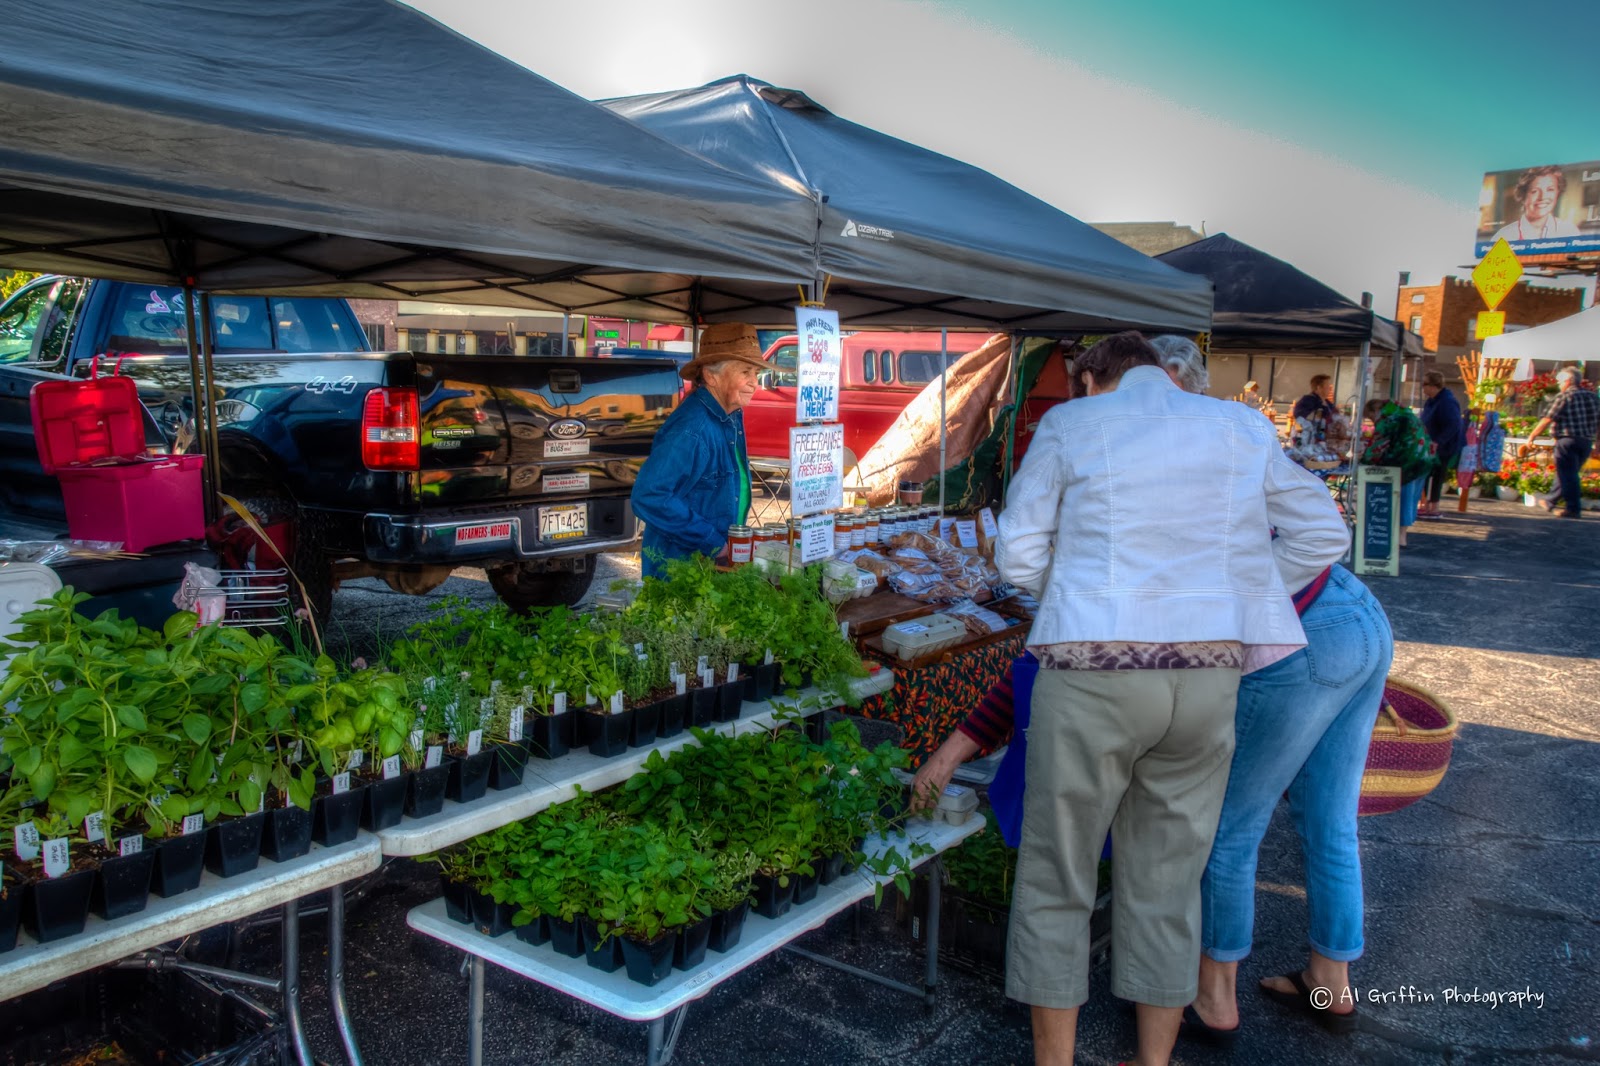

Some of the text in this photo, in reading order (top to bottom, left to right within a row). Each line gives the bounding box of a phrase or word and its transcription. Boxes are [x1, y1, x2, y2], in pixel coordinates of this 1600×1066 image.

[1486, 256, 1511, 267] RIGHT
[1486, 270, 1508, 280] LANE
[1484, 283, 1507, 294] ENDS
[805, 317, 834, 335] FARM FRESH
[305, 375, 358, 395] 4x4
[801, 385, 833, 402] FOR SALE
[805, 401, 826, 417] HERE
[550, 445, 564, 453] BUGS
[797, 462, 834, 478] FRESH EGGS
[798, 491, 807, 501] ALL
[804, 500, 812, 509] ALL
[541, 511, 586, 533] 7FT 425
[813, 521, 823, 529] Fresh
[824, 519, 833, 527] Eggs
[457, 523, 510, 541] NO FARMERS NO FOOD
[51, 845, 59, 864] SAGE
[59, 842, 68, 864] GOLDEN
